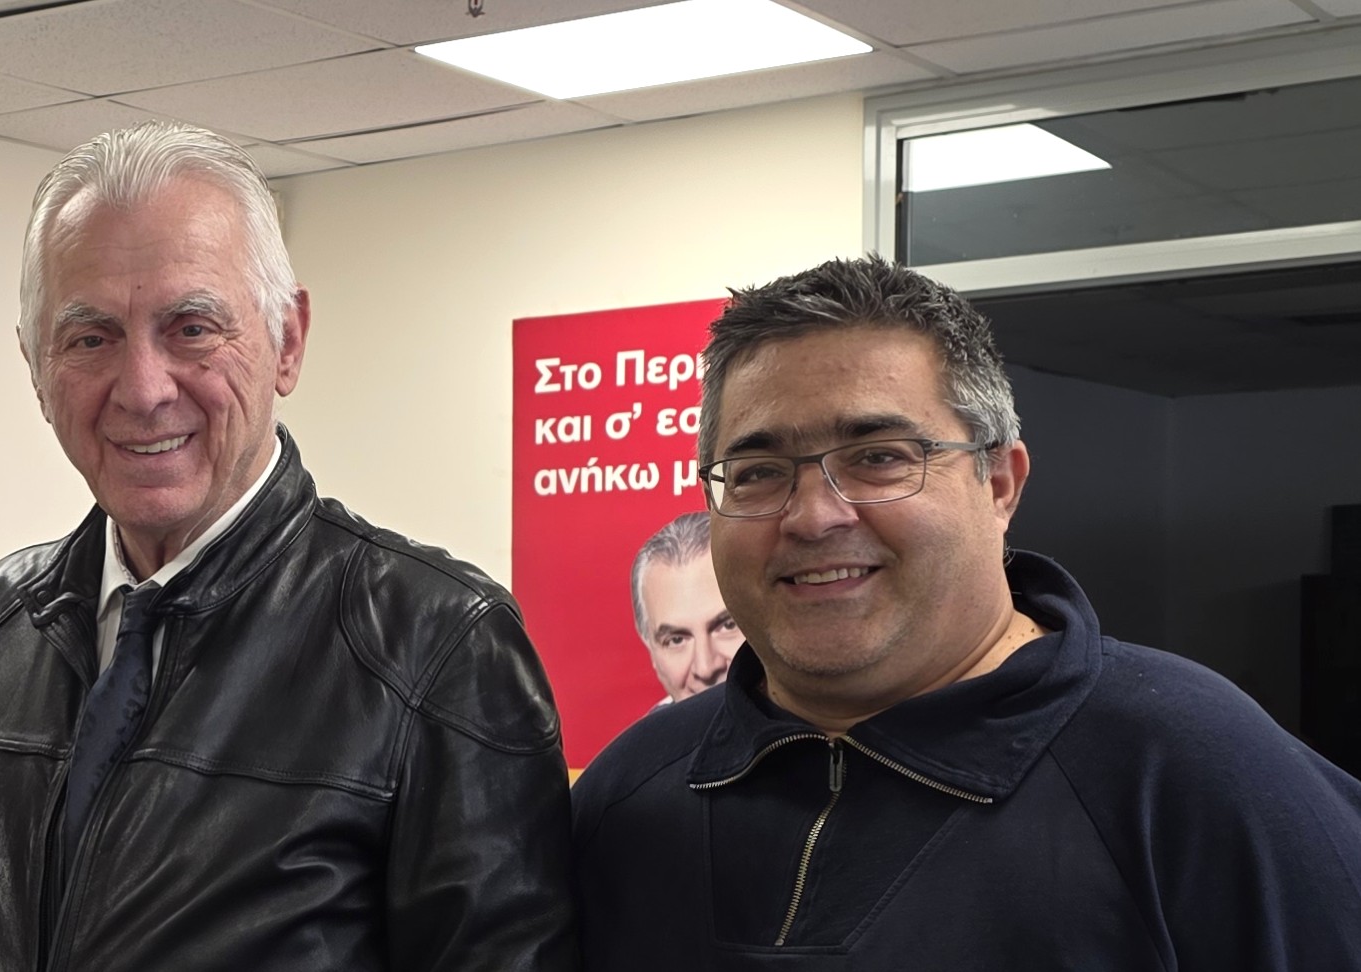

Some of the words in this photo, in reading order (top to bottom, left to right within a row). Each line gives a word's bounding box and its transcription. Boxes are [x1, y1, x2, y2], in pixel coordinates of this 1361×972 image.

[534, 357, 602, 394] Στο
[616, 349, 708, 391] Περι
[535, 414, 592, 445] και
[534, 457, 660, 496] ανήκω
